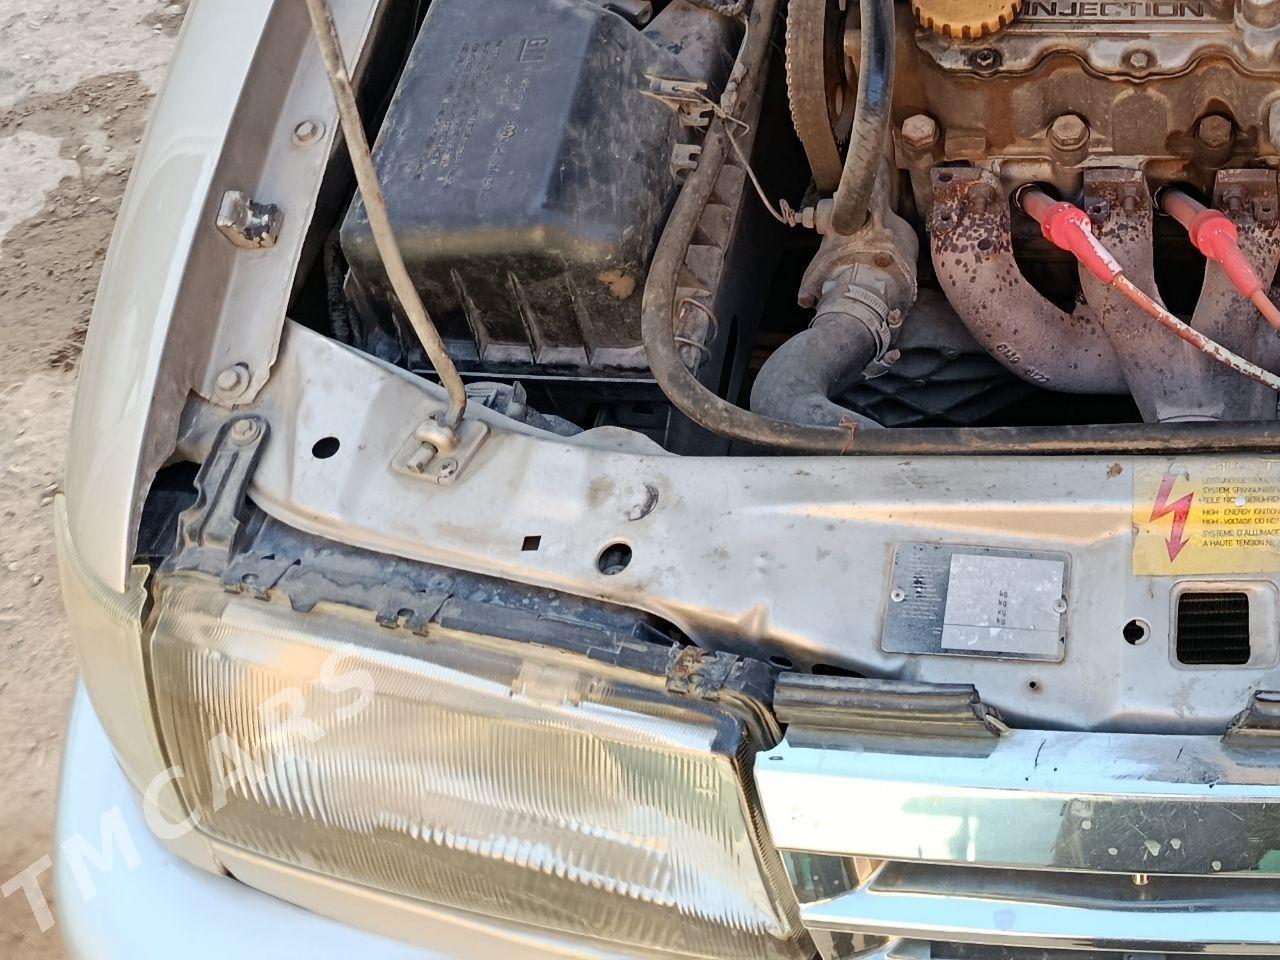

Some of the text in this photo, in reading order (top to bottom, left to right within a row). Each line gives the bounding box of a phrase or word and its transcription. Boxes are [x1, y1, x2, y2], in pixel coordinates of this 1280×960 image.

[1023, 1, 1204, 17] INJECTION
[999, 590, 1008, 599] kg
[998, 599, 1007, 608] kg
[996, 617, 1006, 625] kg
